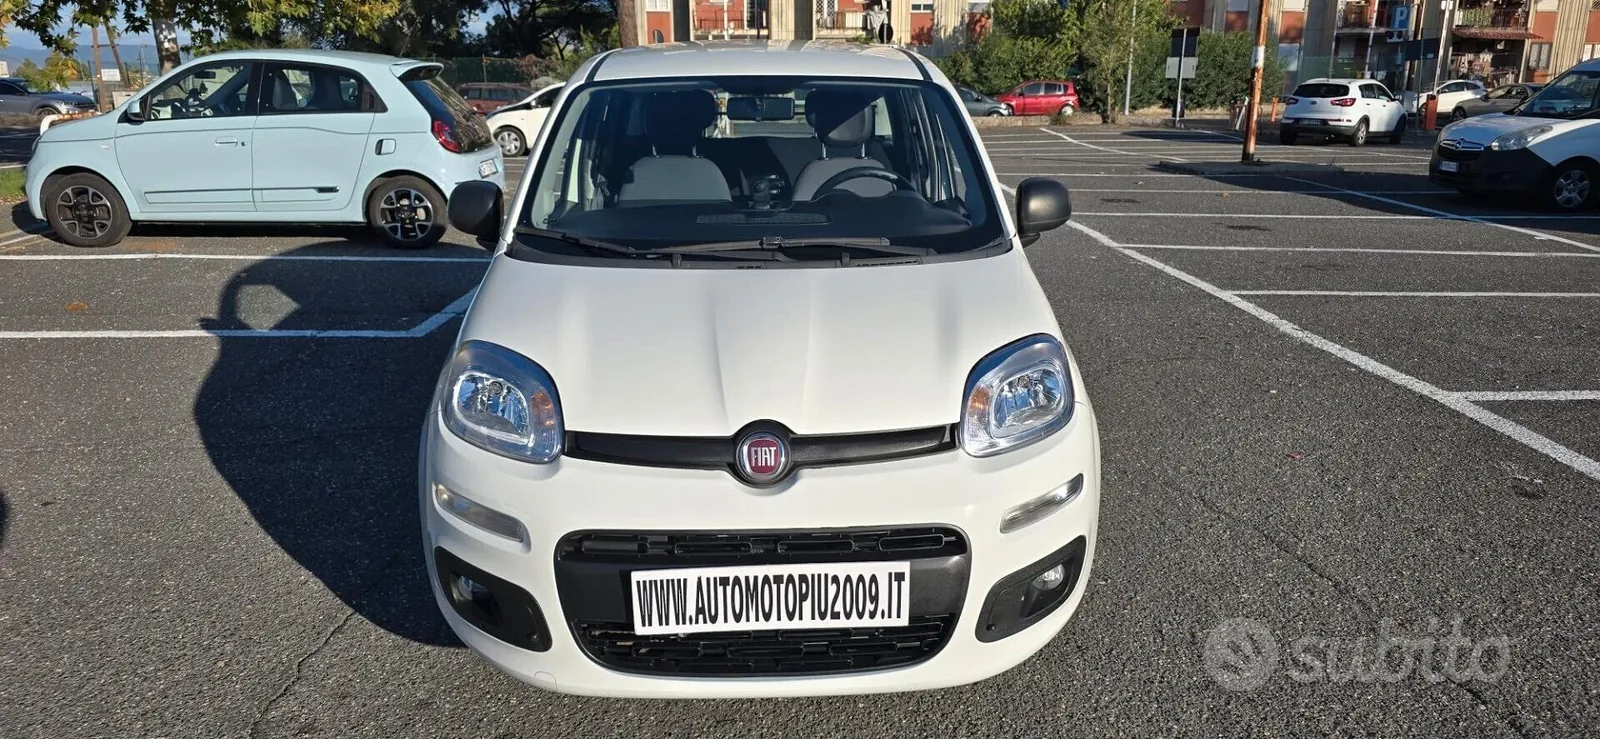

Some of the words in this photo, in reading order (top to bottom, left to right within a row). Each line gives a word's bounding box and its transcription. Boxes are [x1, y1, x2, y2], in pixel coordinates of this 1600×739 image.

[1393, 6, 1408, 29] P
[750, 446, 777, 467] FIAT
[636, 572, 905, 627] WWW.AUTOMOTOPIU2009.IT
